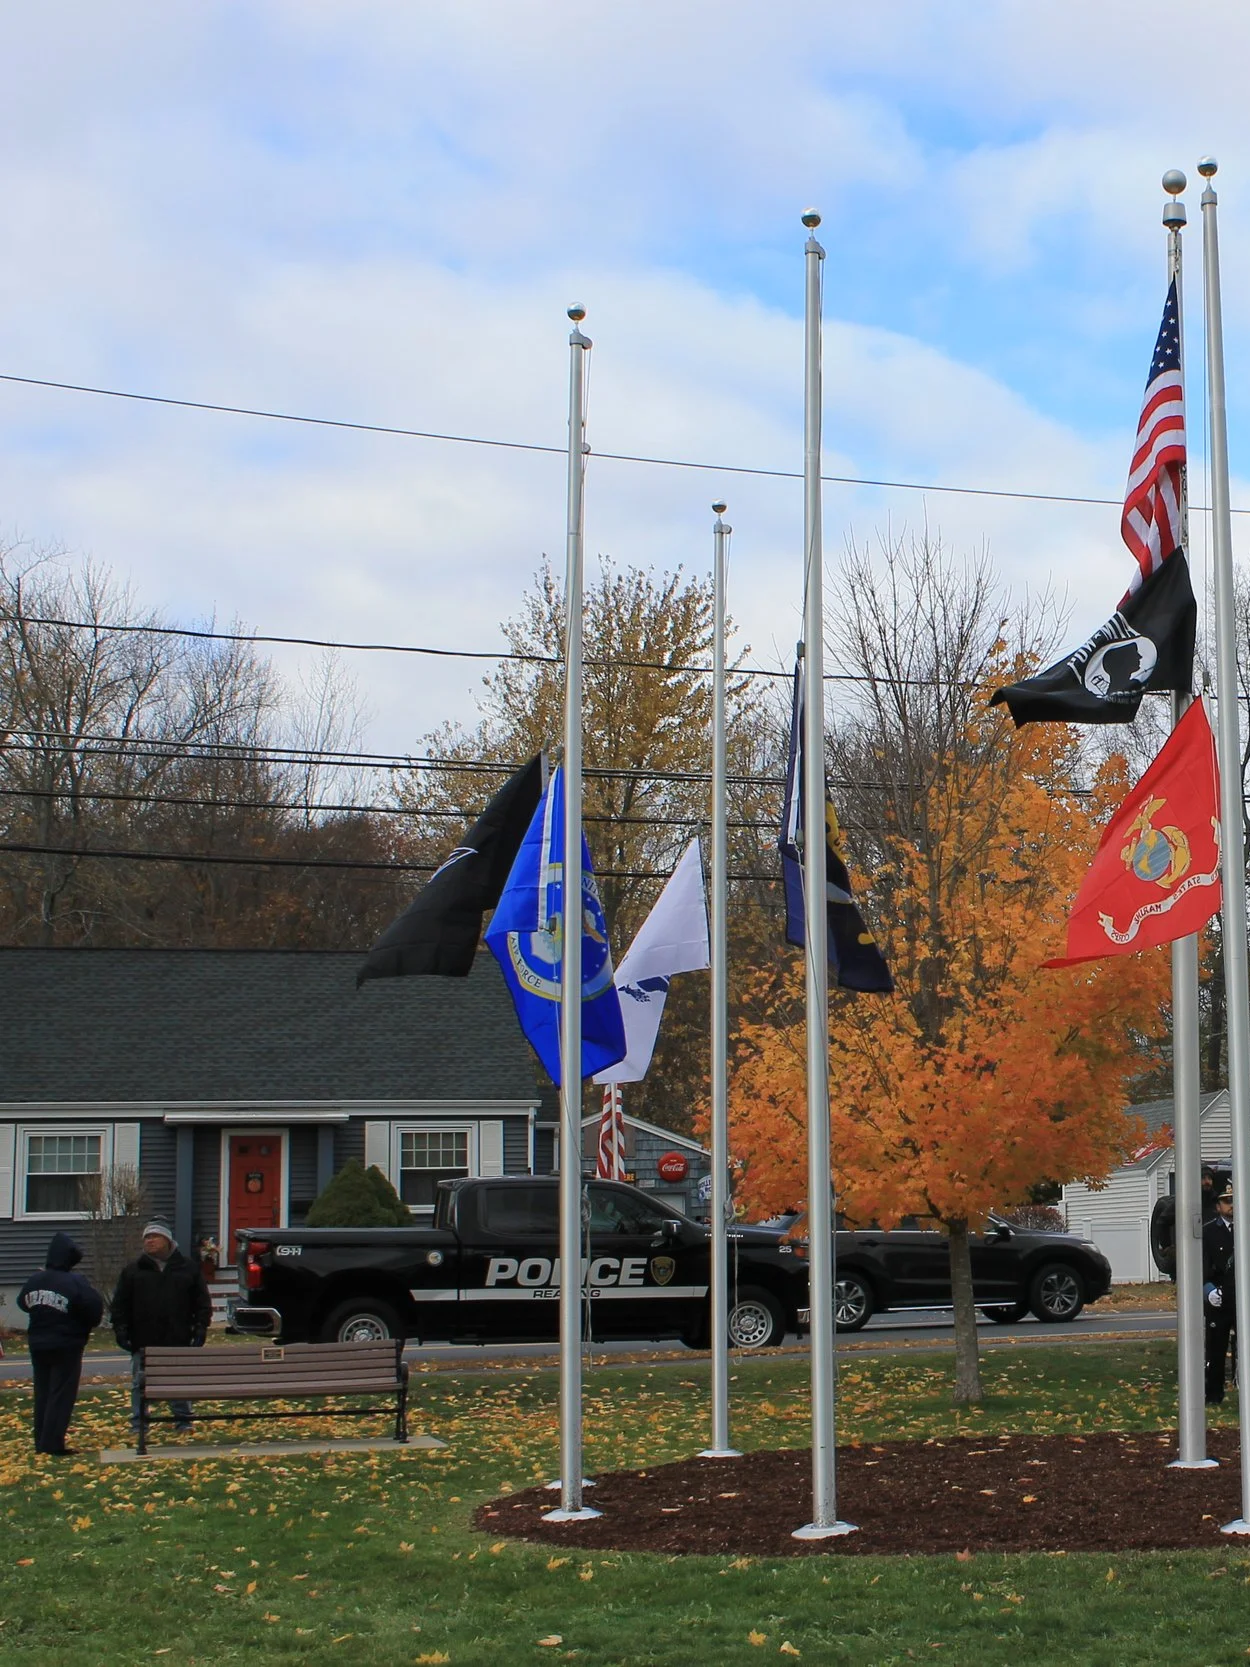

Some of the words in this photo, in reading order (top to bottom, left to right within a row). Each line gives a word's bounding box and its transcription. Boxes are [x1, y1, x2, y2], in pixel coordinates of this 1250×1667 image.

[510, 936, 520, 957] AIR
[515, 957, 542, 989] FORCE
[661, 1163, 685, 1172] Coca-Cola
